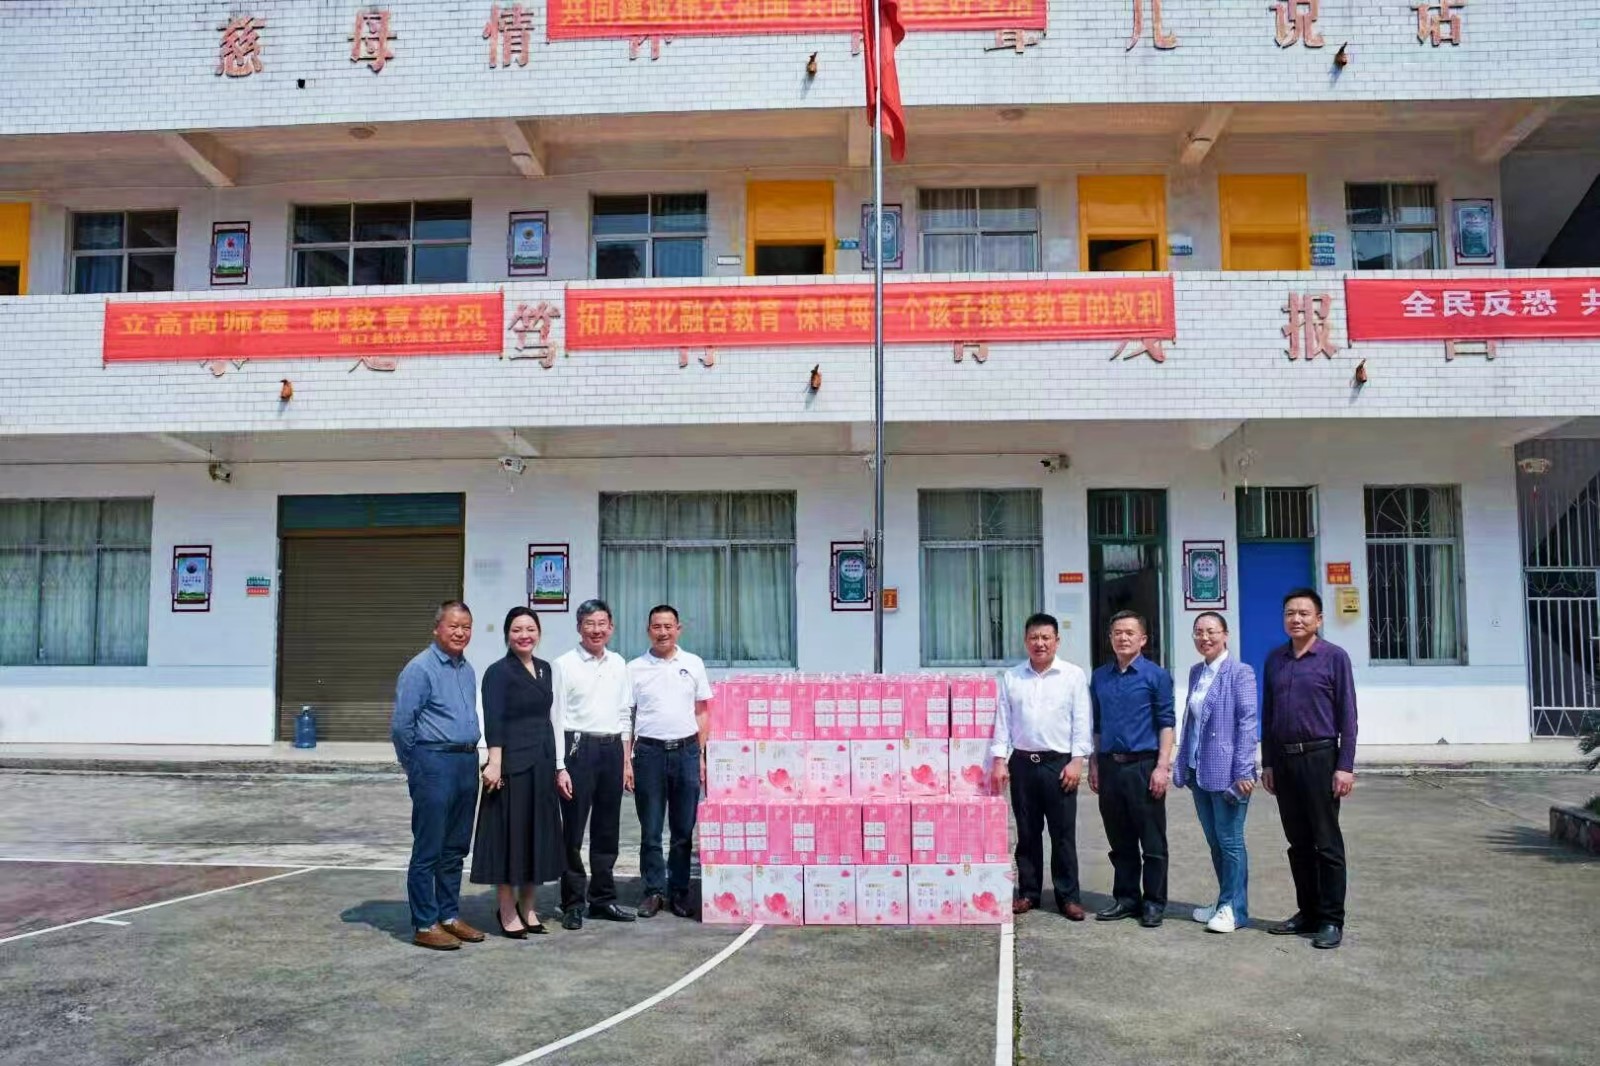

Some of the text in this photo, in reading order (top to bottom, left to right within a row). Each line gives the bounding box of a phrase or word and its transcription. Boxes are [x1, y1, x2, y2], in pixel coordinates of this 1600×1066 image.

[119, 303, 488, 335] 立高尚师德 树教育新风
[576, 288, 1163, 337] 拓展深化融合教育 保障每一个孩子接受教育的权利
[1401, 289, 1557, 317] 全民反恐
[1281, 291, 1337, 360] 报
